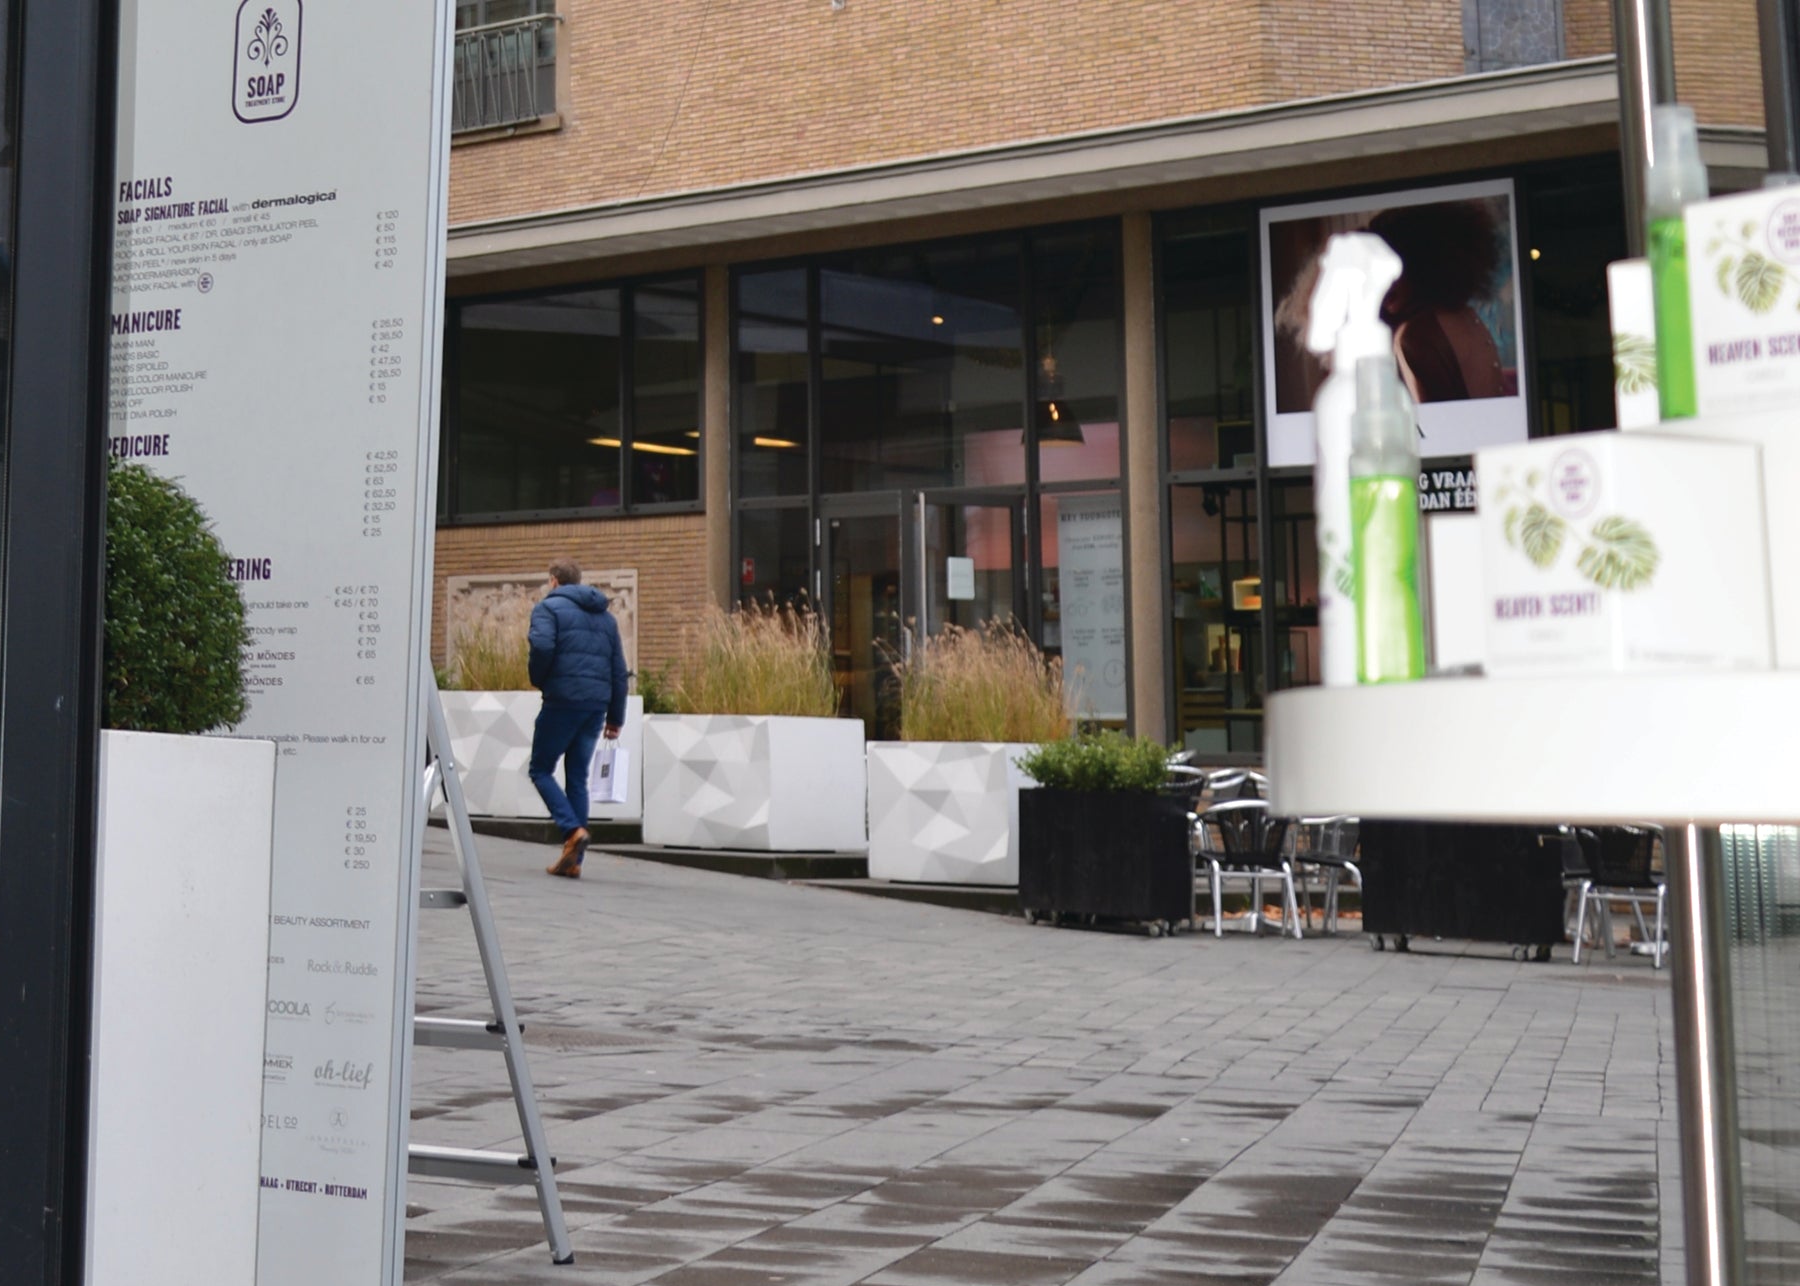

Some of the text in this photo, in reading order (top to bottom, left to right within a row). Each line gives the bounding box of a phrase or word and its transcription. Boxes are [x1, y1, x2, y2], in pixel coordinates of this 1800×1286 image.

[247, 72, 285, 98] SOAP
[119, 176, 173, 203] FACIALS
[117, 208, 142, 225] SOAP
[144, 201, 195, 222] SIGNATURE
[197, 197, 229, 216] FACIAL
[111, 308, 182, 335] MANICURE
[1767, 333, 1800, 358] SCE
[1431, 470, 1476, 489] VRAA
[314, 1059, 374, 1090] oh-lief
[286, 1179, 318, 1194] UTRECHT
[324, 1183, 368, 1200] ROTTERDAM
